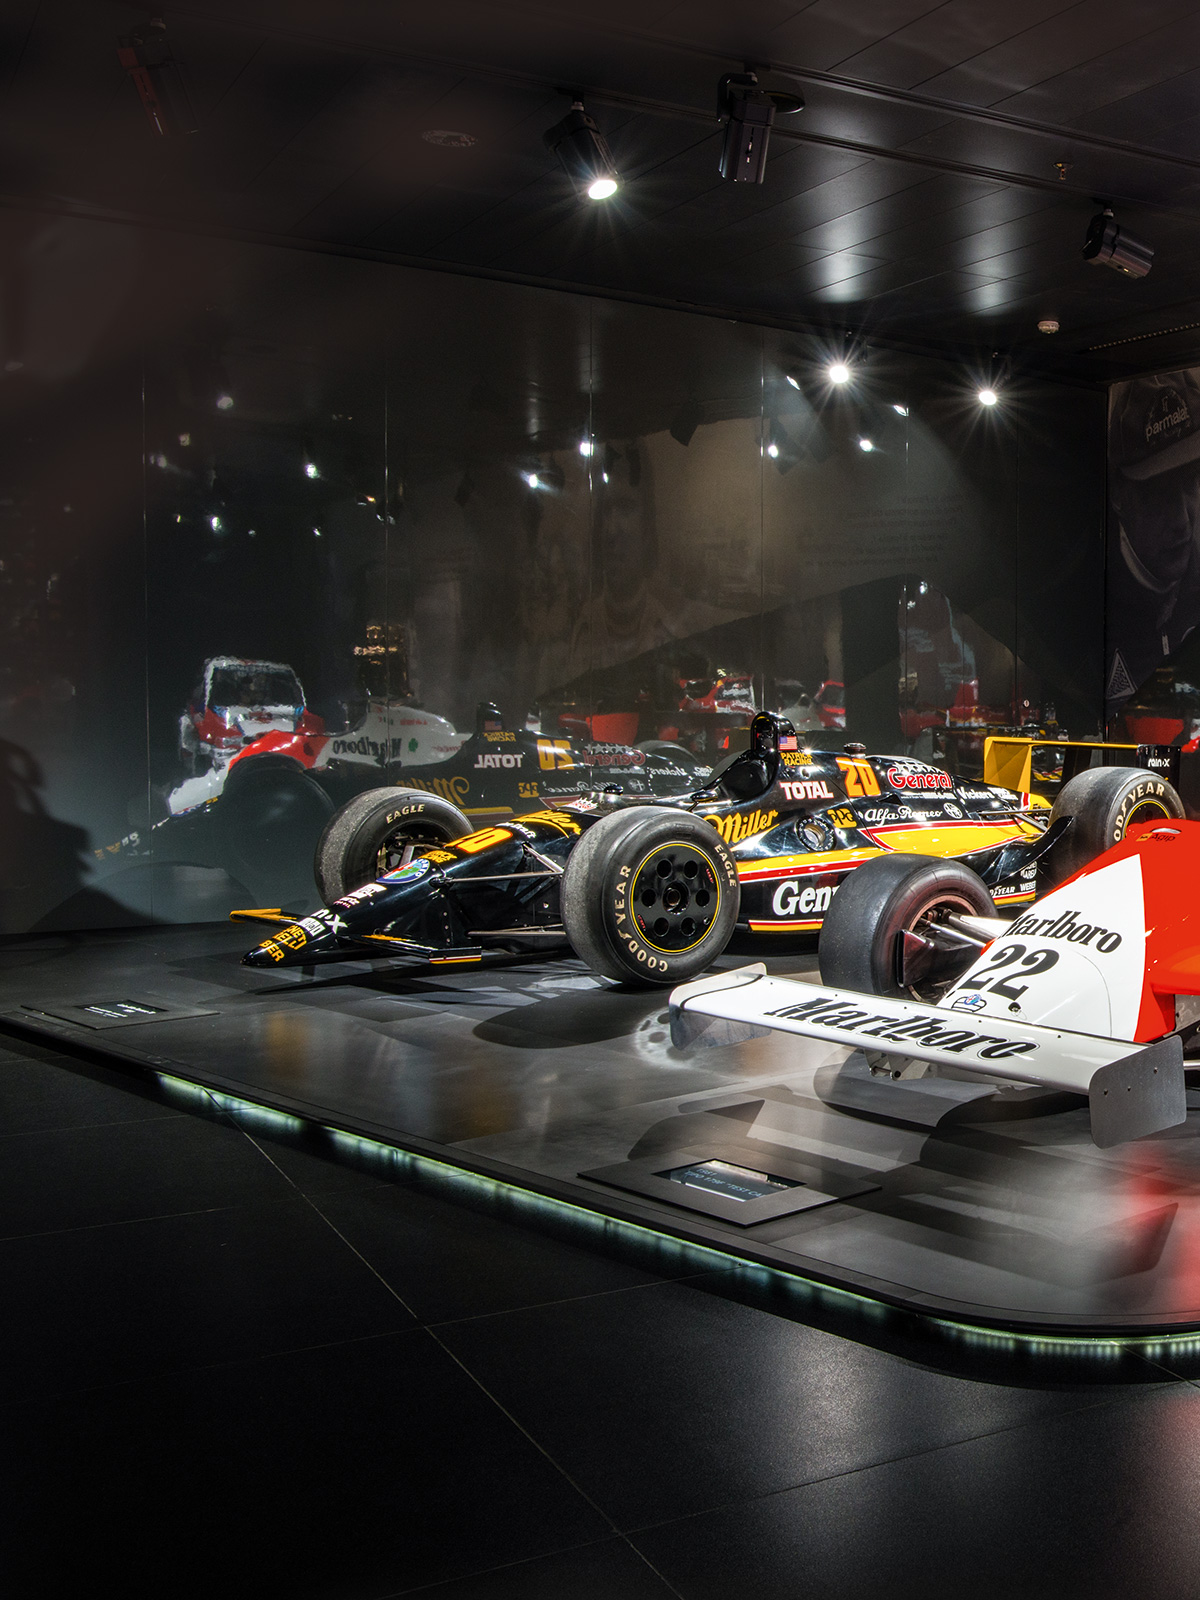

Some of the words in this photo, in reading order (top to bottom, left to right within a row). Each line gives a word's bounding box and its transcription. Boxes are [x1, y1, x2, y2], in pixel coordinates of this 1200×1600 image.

[780, 752, 813, 760] PATRICK
[779, 780, 835, 800] TOTAL
[836, 757, 881, 798] 20
[886, 768, 952, 790] General
[386, 803, 425, 825] EAGLE
[703, 809, 779, 844] Miller
[864, 807, 900, 828] Alfa
[897, 805, 943, 822] Romeo
[714, 844, 738, 888] EAGLE
[772, 880, 841, 916] Gen
[614, 865, 669, 973] GOODYEAR
[1002, 910, 1123, 954] Marlboro
[259, 939, 285, 963] BER
[957, 943, 1060, 1001] 22
[763, 996, 1038, 1060] Marlboro
